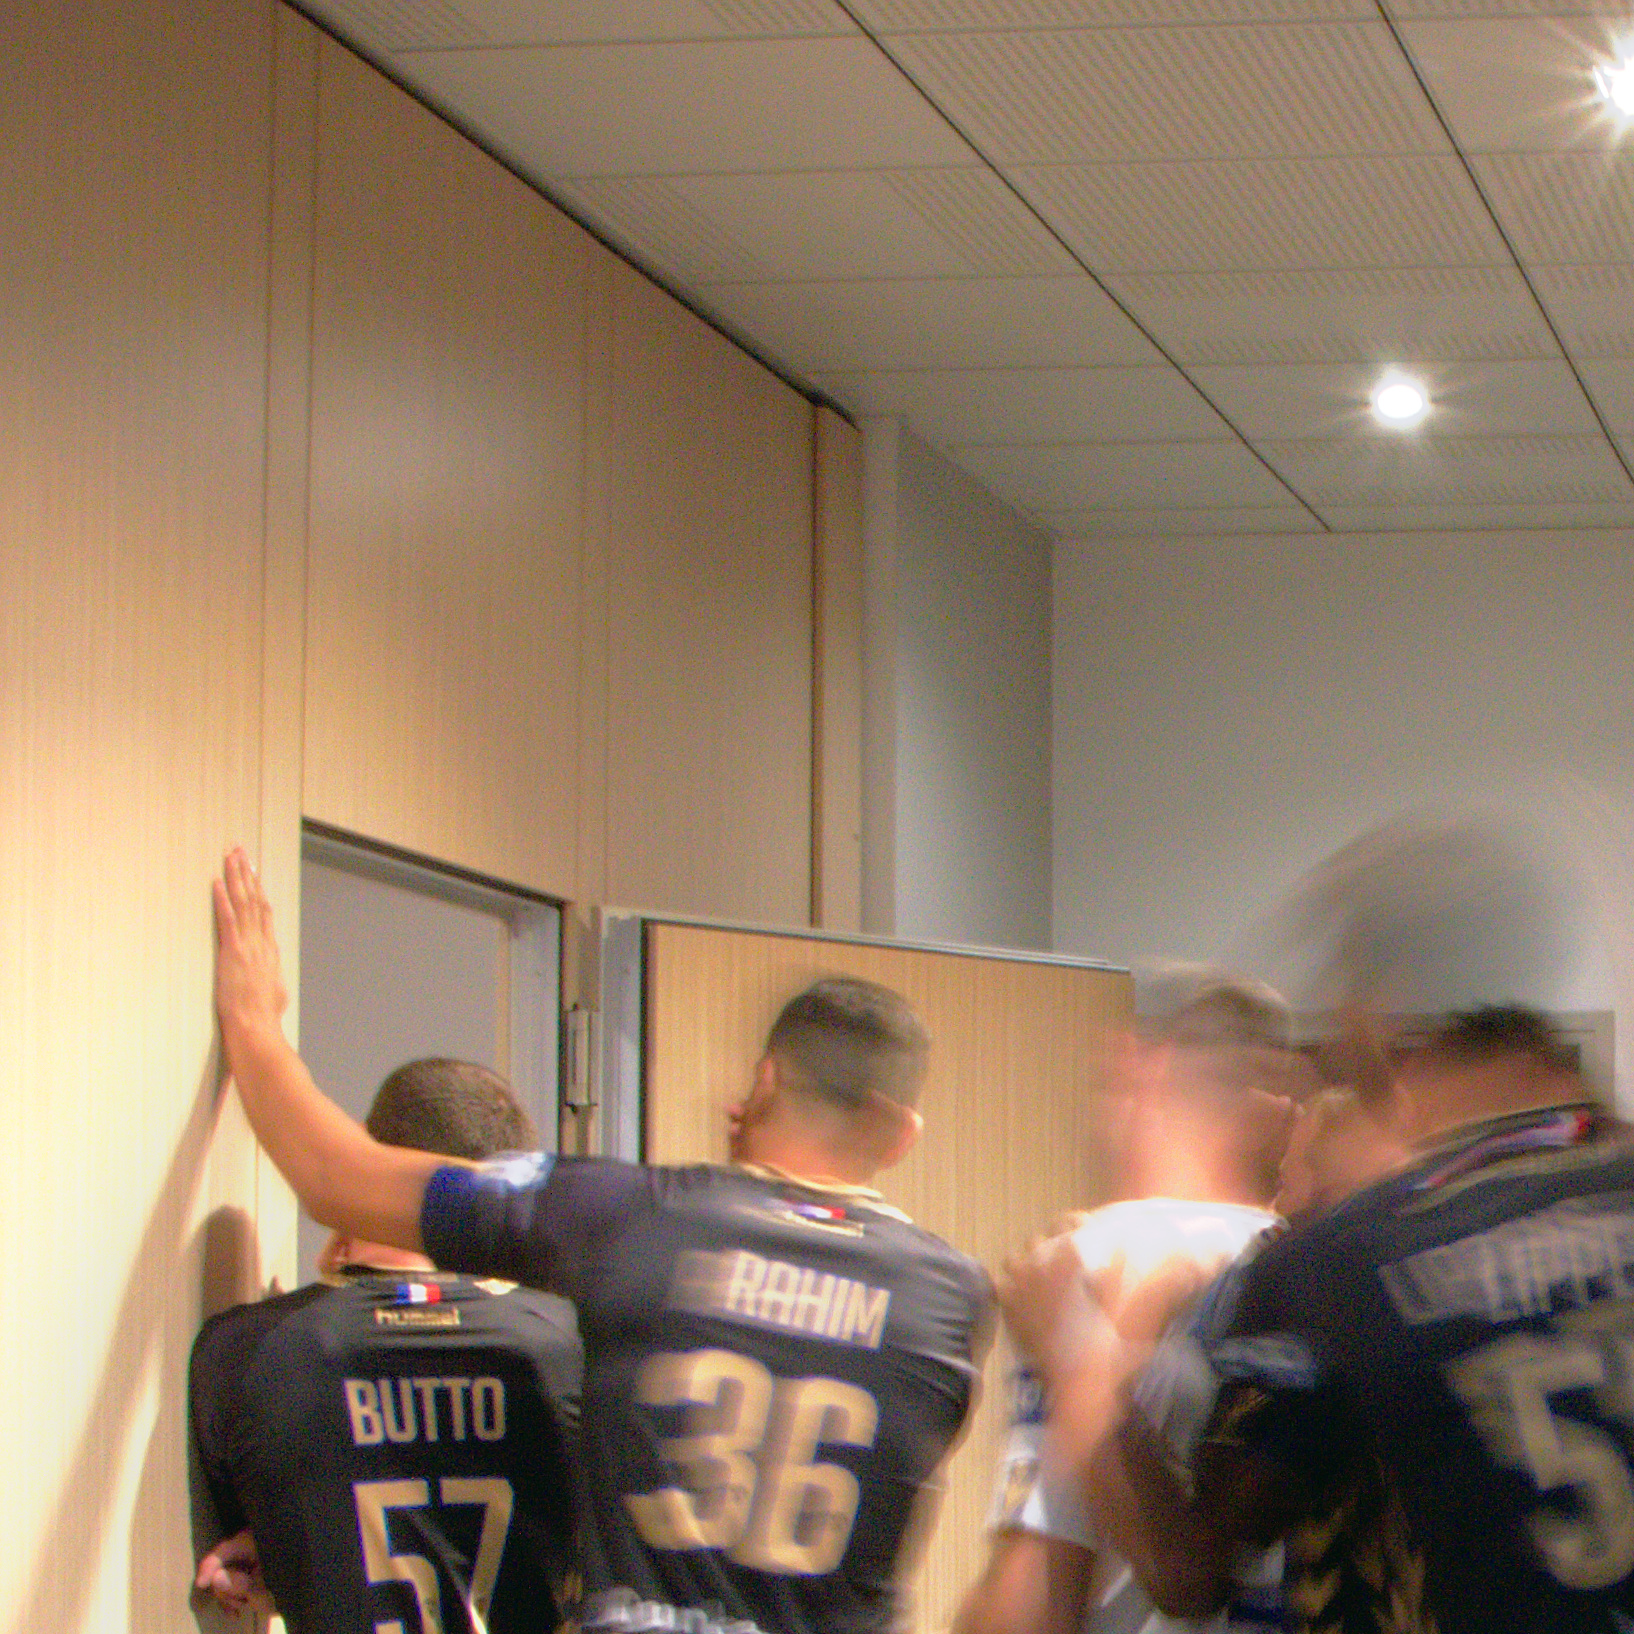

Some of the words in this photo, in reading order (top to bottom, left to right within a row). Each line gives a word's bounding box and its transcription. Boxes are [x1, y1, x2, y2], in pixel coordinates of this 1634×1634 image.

[724, 1250, 891, 1352] RAHIM
[344, 1376, 506, 1447] BUTTO
[622, 1349, 878, 1577] 36
